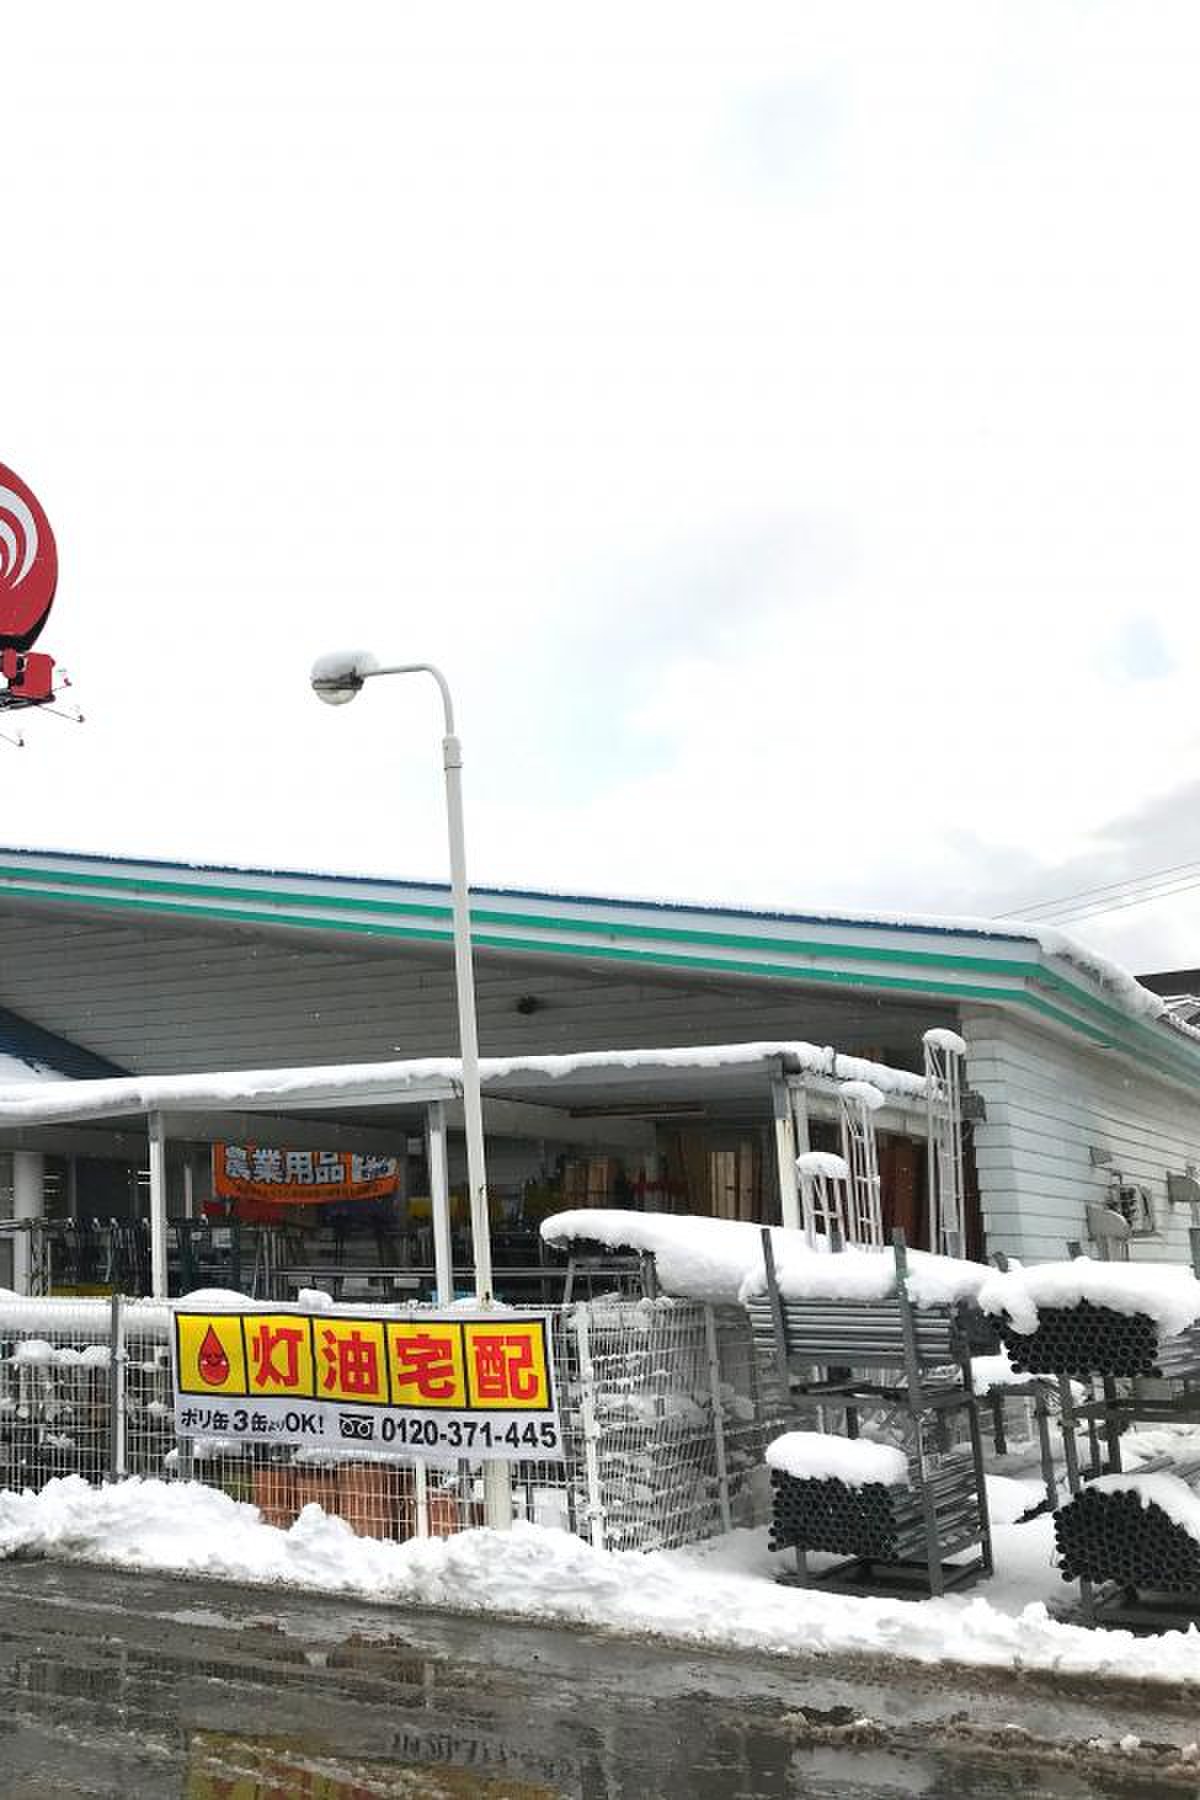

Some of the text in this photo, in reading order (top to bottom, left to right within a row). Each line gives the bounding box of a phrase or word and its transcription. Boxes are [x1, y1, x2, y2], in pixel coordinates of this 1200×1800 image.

[252, 1325, 539, 1400] 灯油宅配
[382, 1417, 558, 1450] 0120-371-445
